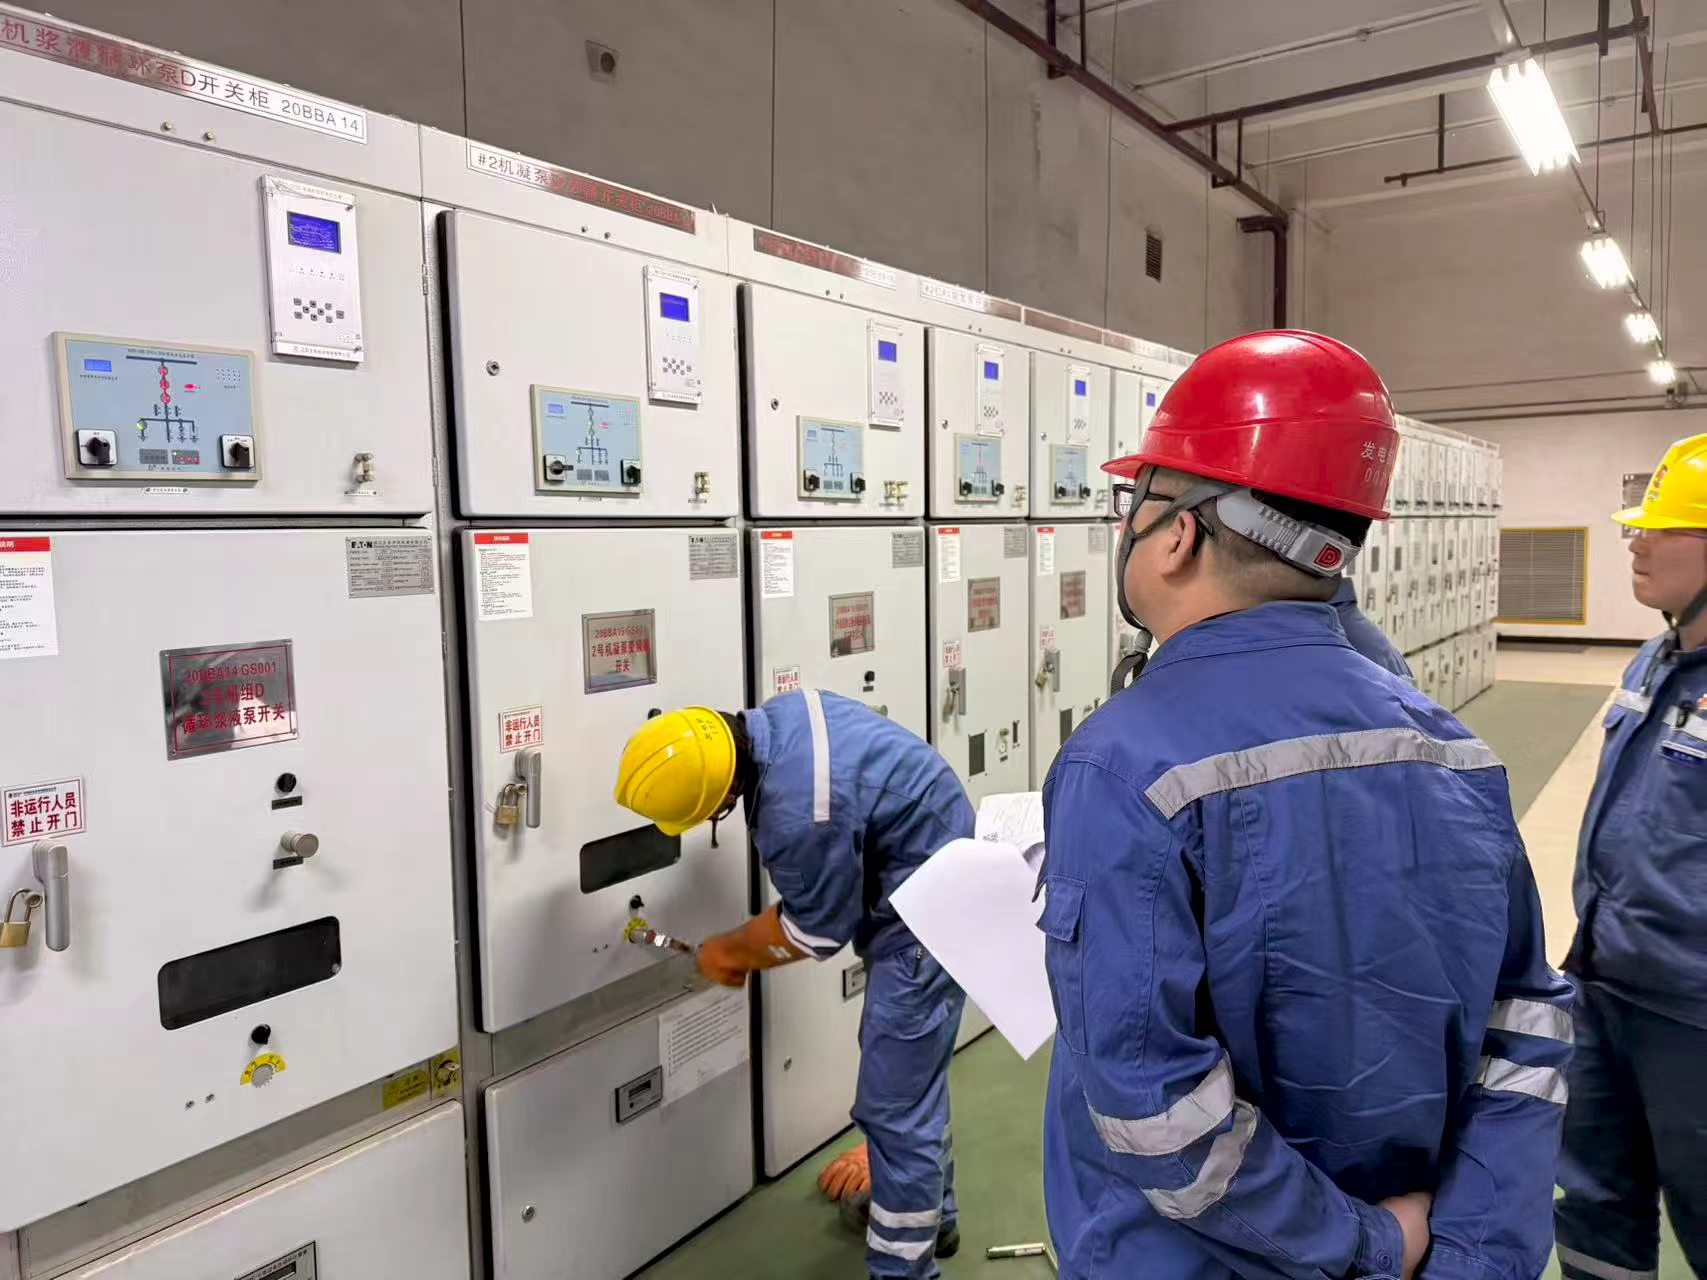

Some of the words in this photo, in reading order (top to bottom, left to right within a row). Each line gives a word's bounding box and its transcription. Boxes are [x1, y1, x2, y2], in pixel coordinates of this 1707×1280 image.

[615, 659, 631, 672] 开关
[504, 714, 540, 732] 非运行人员
[505, 728, 541, 746] 禁止开门
[10, 792, 77, 818] 非运行人员
[11, 811, 78, 838] 禁止开门
